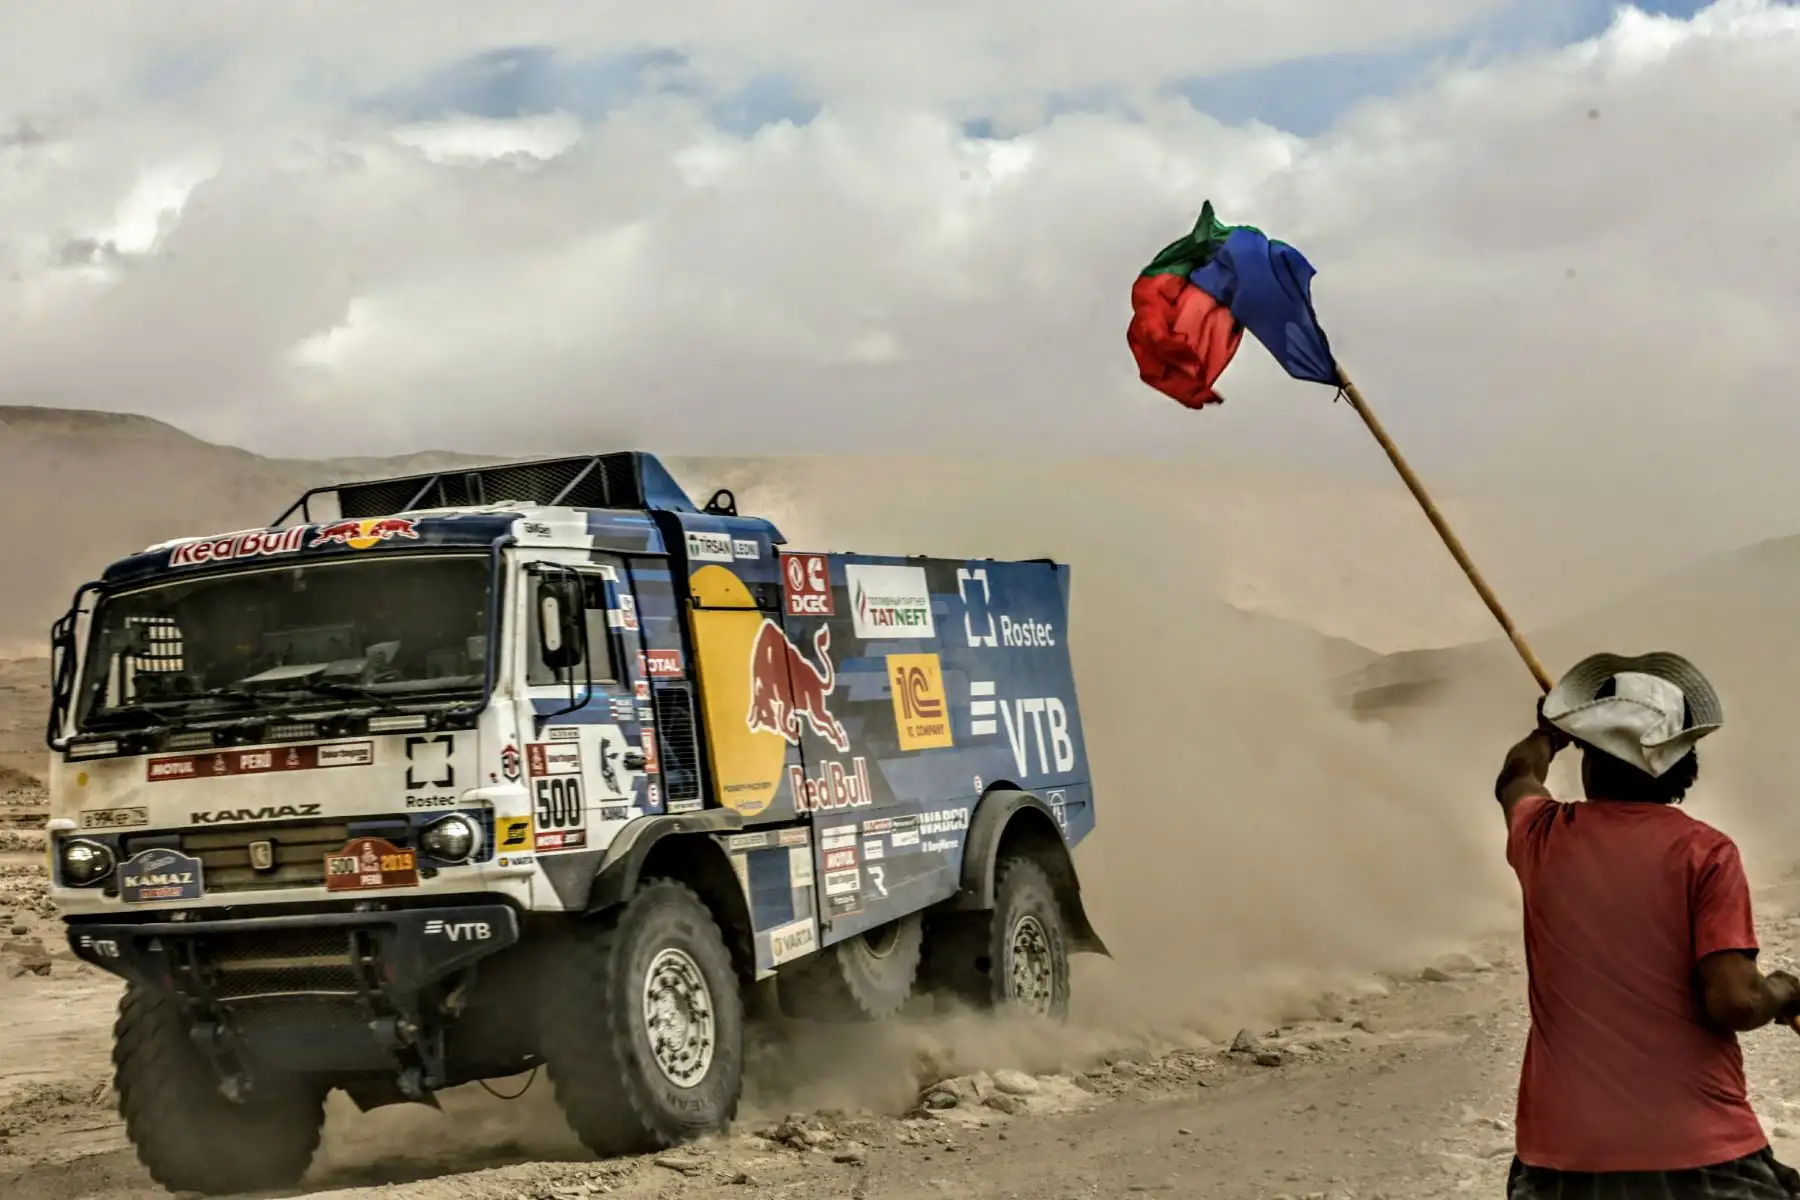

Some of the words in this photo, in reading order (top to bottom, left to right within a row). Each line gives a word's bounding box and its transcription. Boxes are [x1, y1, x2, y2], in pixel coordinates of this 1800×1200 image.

[237, 525, 306, 558] Bull
[869, 608, 928, 626] TATNEFT
[1000, 615, 1055, 647] Rostec
[638, 654, 681, 673] TOTAL
[999, 697, 1074, 778] VTB
[151, 761, 196, 776] MOTUL
[789, 760, 833, 813] Red
[829, 757, 872, 808] Bull
[405, 795, 456, 808] Rostec
[537, 778, 582, 829] 500
[190, 803, 322, 824] KAMAZ
[920, 808, 969, 835] WABCO
[124, 872, 193, 888] KAMAZ
[443, 922, 492, 942] VTB
[90, 939, 120, 958] VTB
